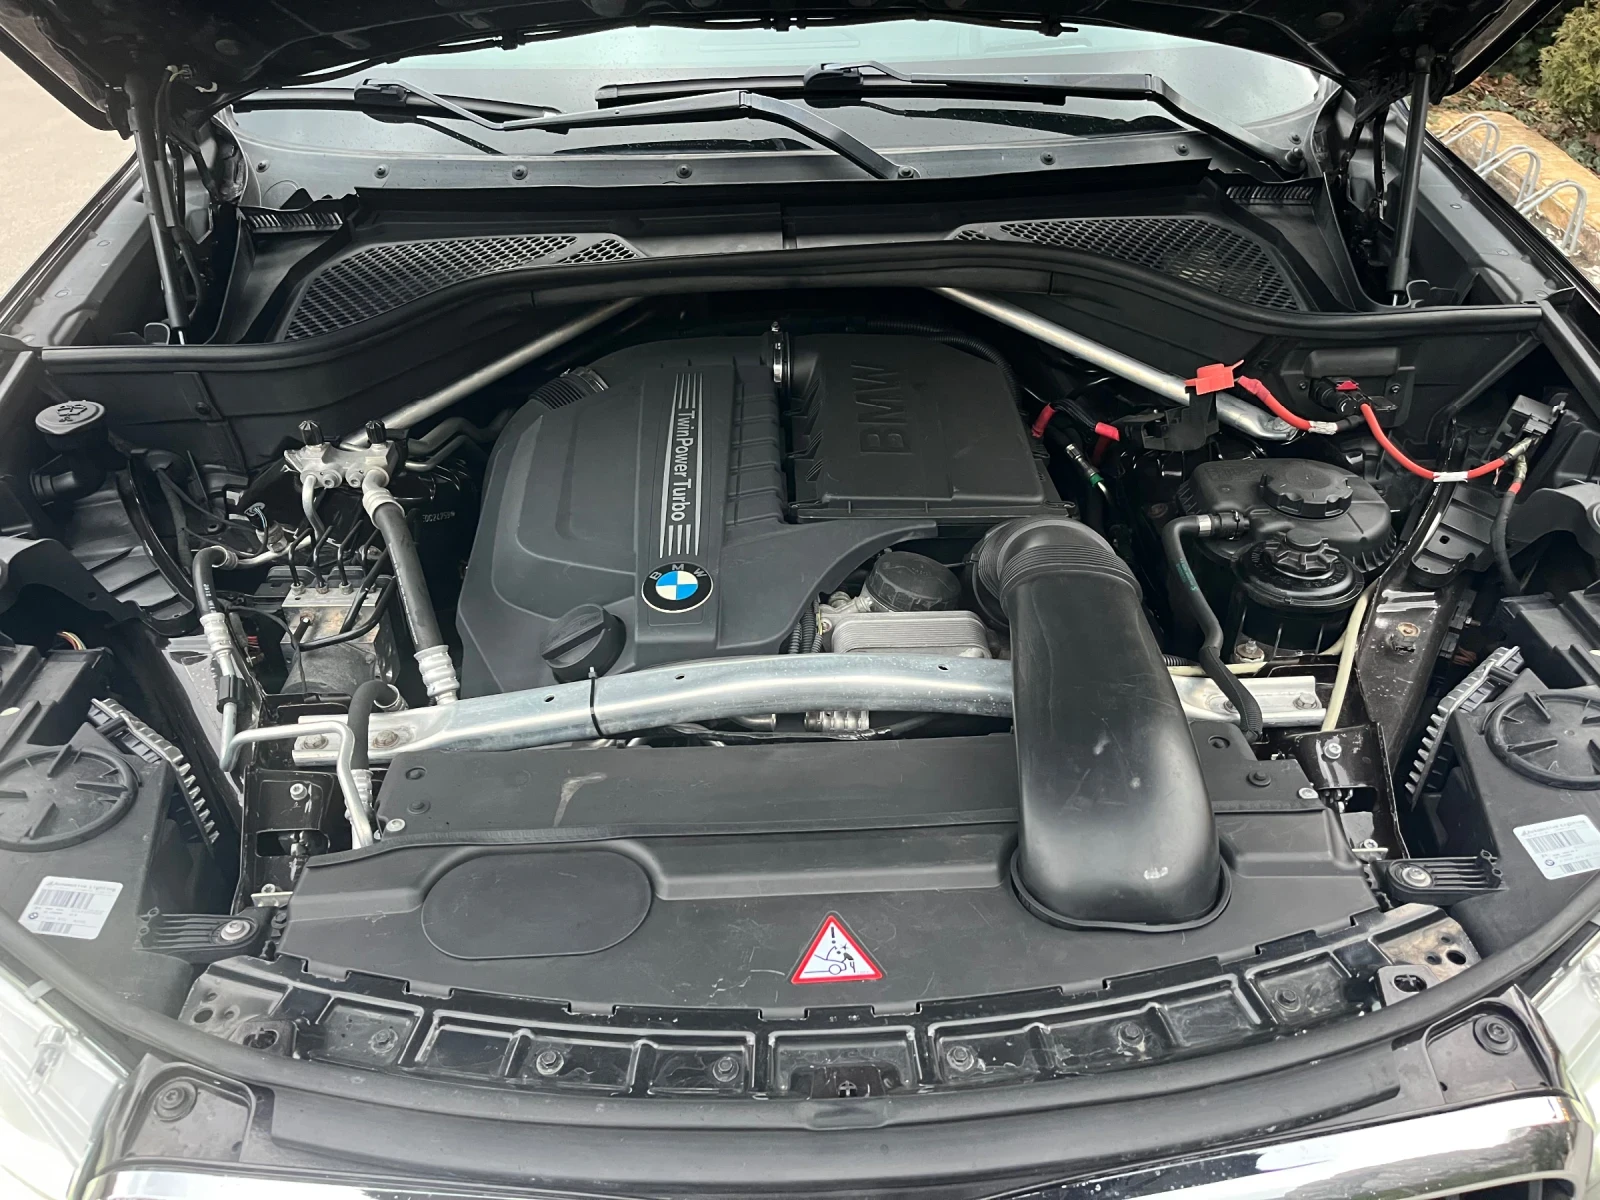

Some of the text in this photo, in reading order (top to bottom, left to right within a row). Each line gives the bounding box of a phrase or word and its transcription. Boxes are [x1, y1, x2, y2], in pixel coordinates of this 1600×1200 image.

[851, 364, 913, 455] BMW
[671, 410, 695, 522] TwinPower Turbo
[649, 563, 708, 580] BMW
